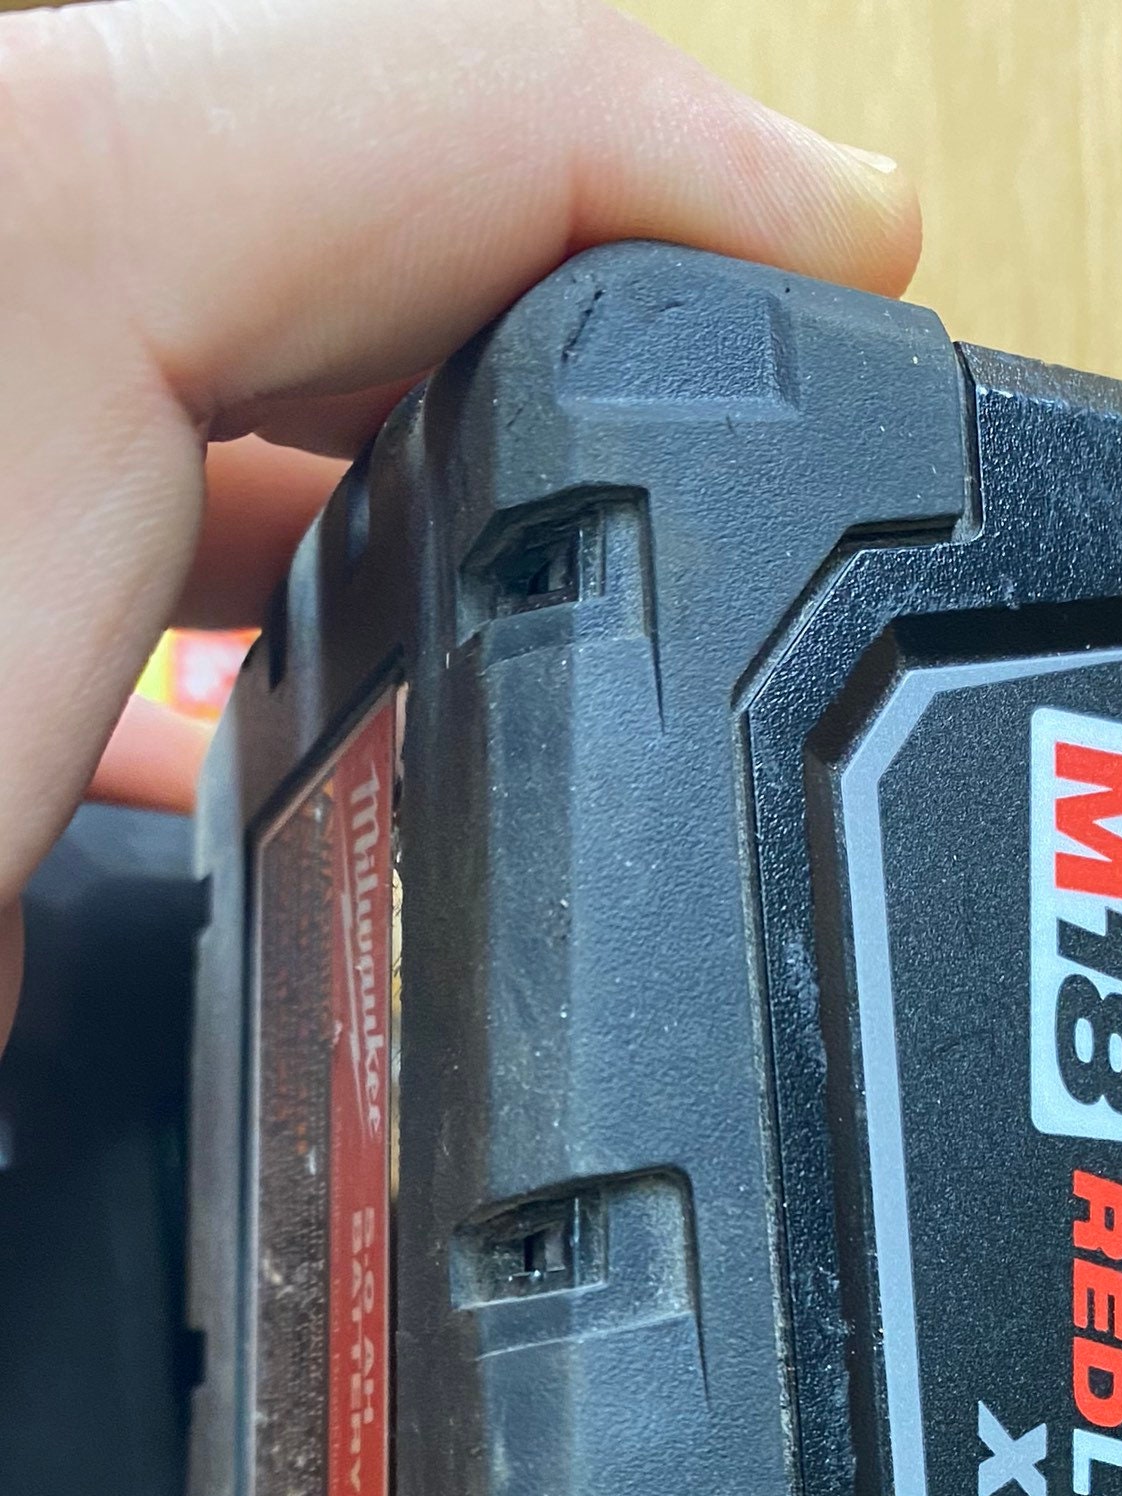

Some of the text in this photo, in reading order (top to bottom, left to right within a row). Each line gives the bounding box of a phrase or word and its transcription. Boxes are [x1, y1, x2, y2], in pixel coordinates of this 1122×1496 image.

[350, 760, 385, 1141] Milwaukee
[350, 1210, 363, 1494] BATTERY
[363, 1206, 375, 1426] 5.0 AH
